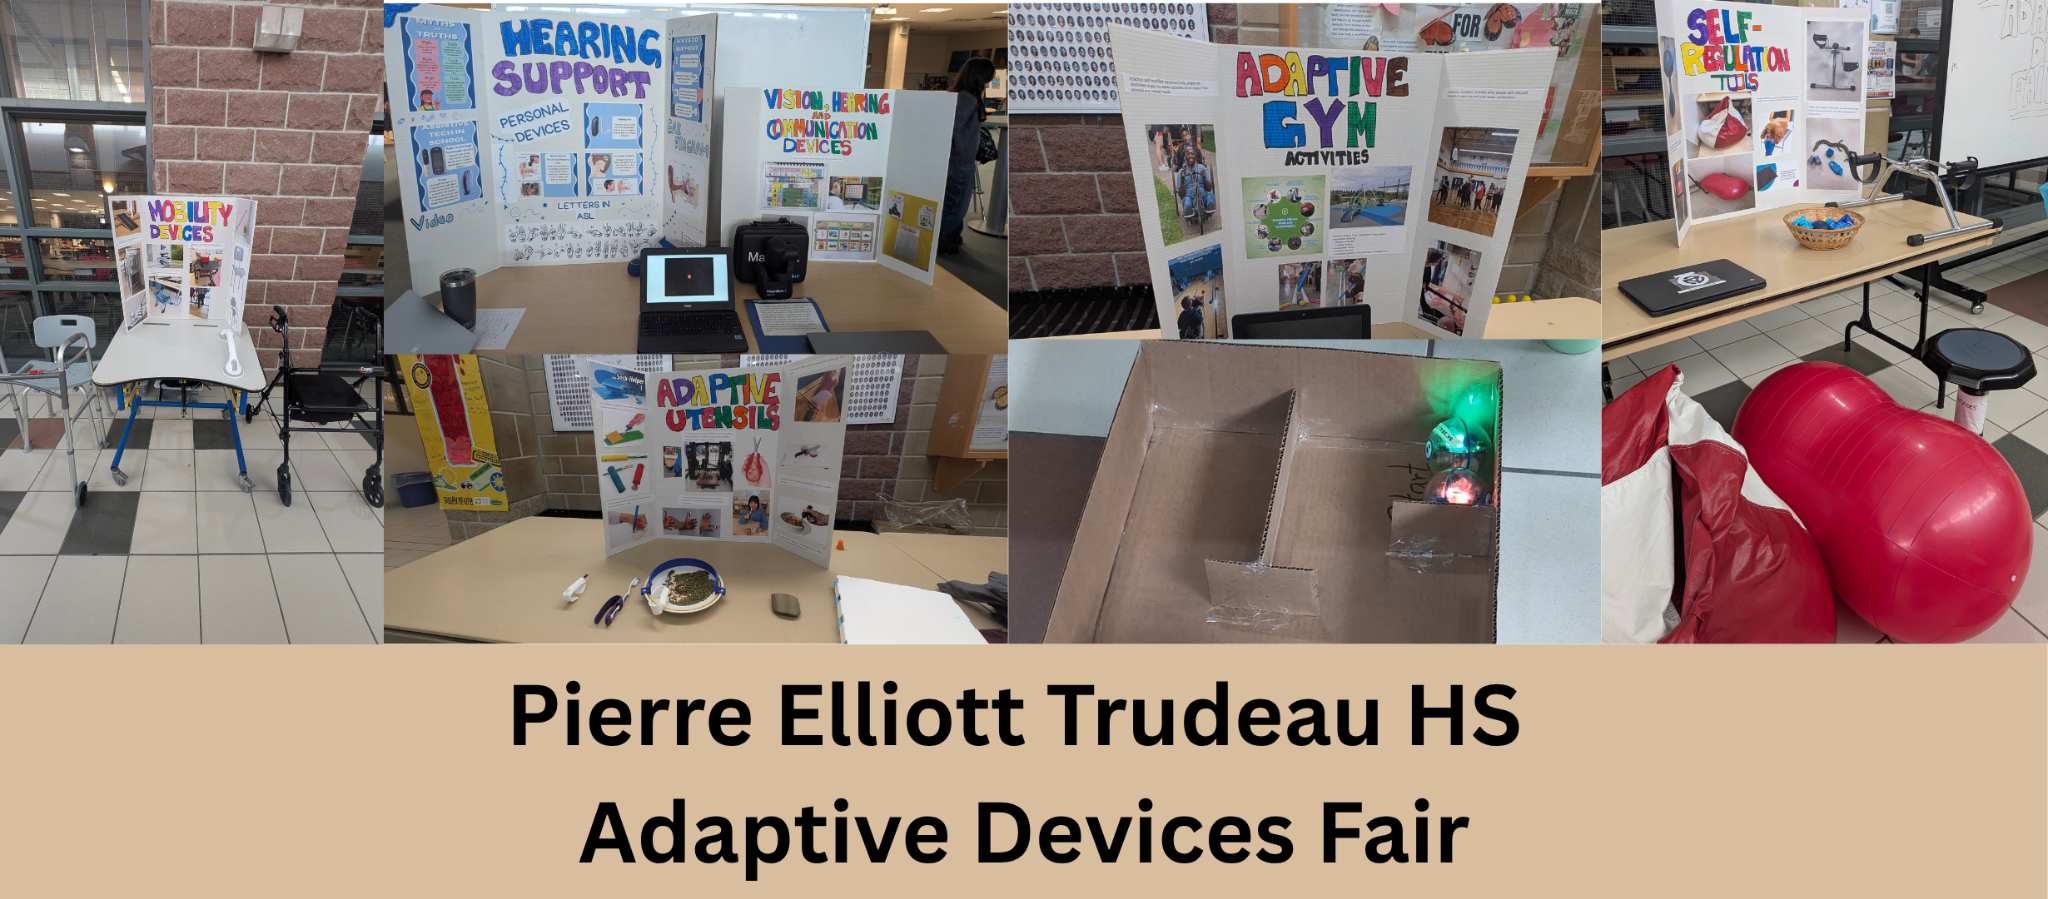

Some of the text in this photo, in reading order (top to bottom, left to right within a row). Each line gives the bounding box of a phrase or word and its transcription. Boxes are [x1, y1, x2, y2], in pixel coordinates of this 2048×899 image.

[416, 31, 458, 40] TRUTHS
[1453, 13, 1481, 38] FOR
[1687, 8, 1762, 46] SELF-
[499, 18, 662, 68] HEARING
[1680, 42, 1791, 77] REGULATION
[492, 60, 652, 99] SUPPORT
[1236, 51, 1409, 98] ADAPTIVE
[1710, 72, 1760, 92] TOOLS
[692, 108, 698, 117] 4
[763, 89, 890, 114] VISION, HEARING
[499, 101, 570, 129] PERSONAL
[811, 111, 831, 120] AND
[1262, 99, 1376, 149] GYM
[428, 130, 454, 138] TECH
[514, 119, 571, 143] DEVICES
[766, 118, 878, 140] COMMUNICATION
[428, 137, 467, 146] SCHOOL
[674, 136, 710, 158] DIAGRAM
[783, 137, 852, 156] DEVICES
[1284, 149, 1371, 167] ACTIVITIES
[148, 200, 233, 227] MOBILITY
[557, 200, 610, 210] LETTERS IN
[576, 212, 595, 220] ASL
[410, 213, 454, 231] Video
[150, 224, 214, 243] DEVICES
[657, 373, 781, 407] ADAPTIVE
[666, 404, 780, 432] UTENSILS
